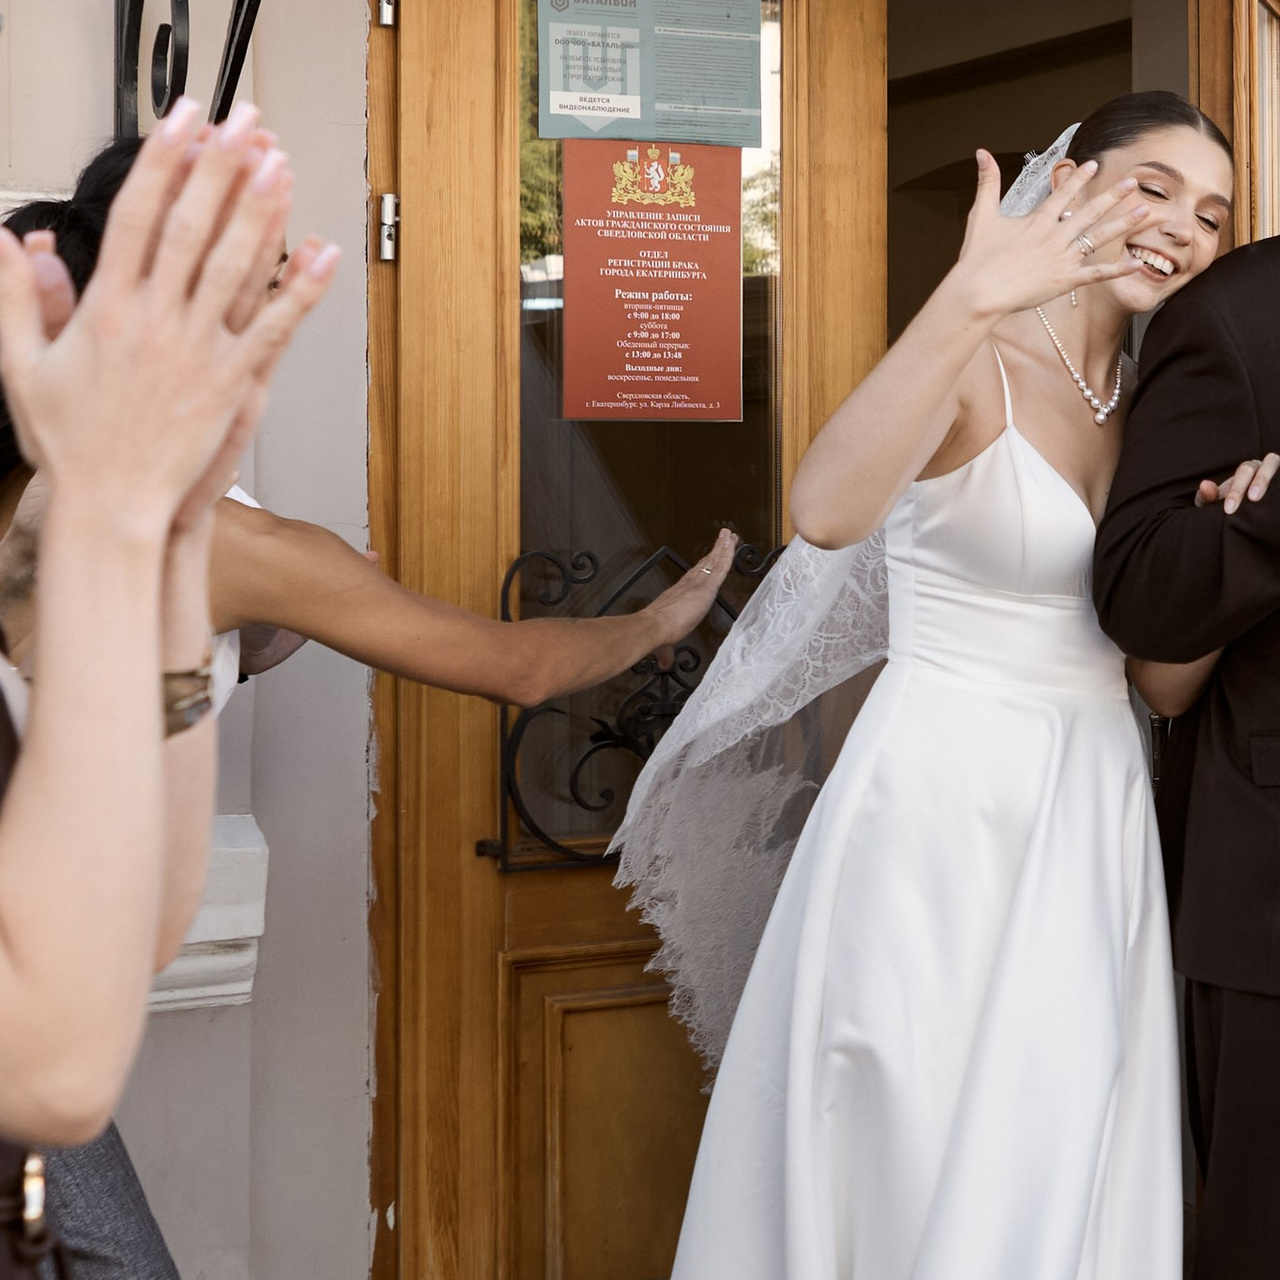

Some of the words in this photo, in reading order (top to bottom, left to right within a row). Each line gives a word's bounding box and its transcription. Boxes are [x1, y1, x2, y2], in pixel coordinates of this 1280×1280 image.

[570, 39, 586, 47] ЧОО
[558, 104, 631, 113] ВИДЕОНАБЛЮДЕНИЕ
[606, 209, 664, 220] УПРАВЛЕНИЕ
[666, 212, 700, 222] ЗАПИСИ
[574, 218, 605, 227] АКТОВ
[606, 219, 677, 231] ГРАЖДАНСКОГО
[678, 223, 731, 233] СОСТОЯНИЯ
[597, 229, 667, 240] СВЕРДЛОВСКОЙ
[668, 232, 709, 242] ОБЛАСТИ
[639, 250, 668, 259] ОТДЕЛ
[607, 258, 670, 269] РЕГИСТРАЦИИ
[672, 261, 699, 270] БРАКА
[600, 268, 634, 277] ГОРОДА
[635, 269, 707, 280] ЕКАТЕРИНБУРГА
[614, 288, 649, 300] Режим
[651, 290, 693, 302] работы:
[623, 303, 684, 311] вторник-пятница
[633, 312, 649, 320] 9:00
[661, 312, 680, 320] 18:00
[639, 321, 668, 331] суббота
[633, 331, 649, 339] 9:00
[661, 331, 680, 339] 17:00
[616, 340, 658, 348] Обеденный
[658, 342, 690, 350] перерыв:
[625, 363, 664, 372] Выходные
[665, 365, 682, 373] дни:
[607, 374, 653, 382] воскресенье,
[616, 391, 662, 400] Свердловская
[663, 393, 690, 401] область,
[650, 401, 670, 410] Карла
